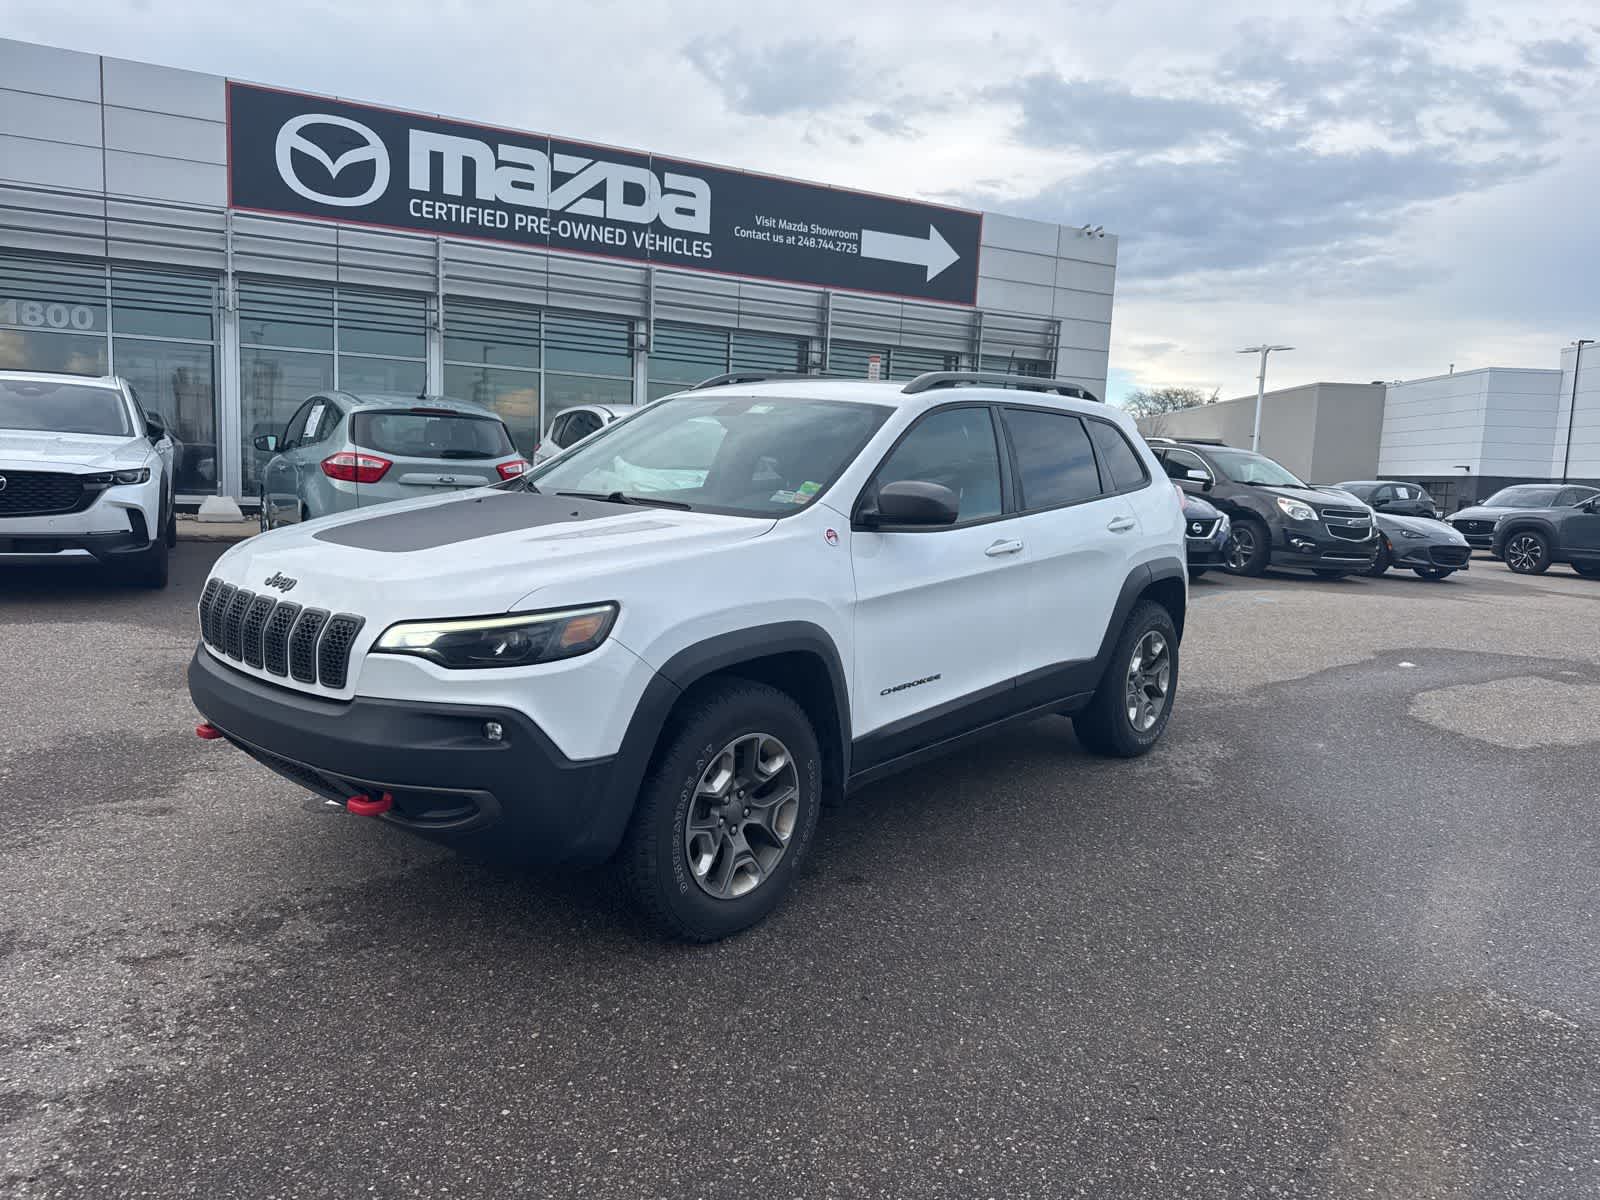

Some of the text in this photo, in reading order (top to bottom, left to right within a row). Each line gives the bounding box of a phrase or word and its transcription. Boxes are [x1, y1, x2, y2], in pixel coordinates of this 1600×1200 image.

[408, 198, 713, 259] CERTIFIED PRE-OWNED VEHICLES
[734, 226, 858, 253] Contact us at 248.744.2725
[755, 215, 859, 240] Visit Mazda Showroom
[264, 571, 298, 594] Jeep
[880, 673, 942, 696] CHEROKEE
